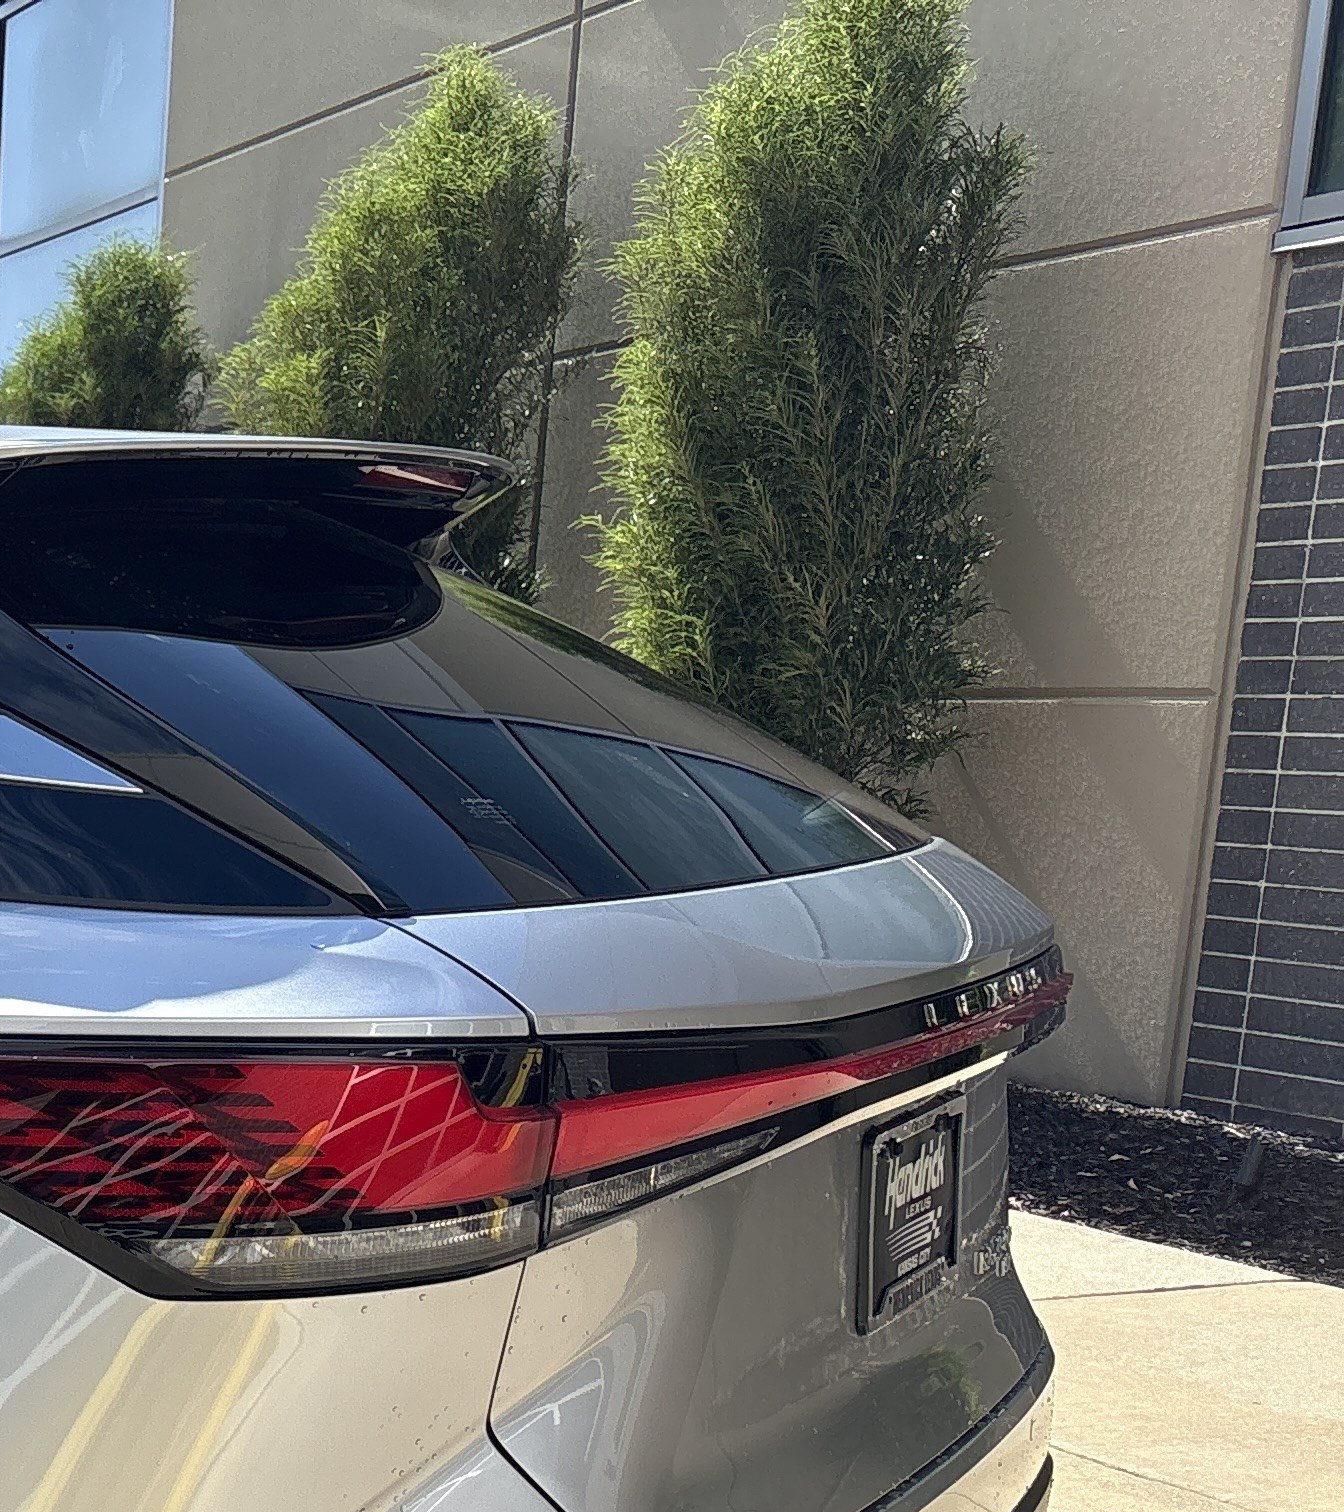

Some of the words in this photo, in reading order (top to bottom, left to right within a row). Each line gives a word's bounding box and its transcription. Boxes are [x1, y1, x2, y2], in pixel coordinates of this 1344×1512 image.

[923, 967, 1042, 1028] LEXUS
[884, 1132, 946, 1230] Hendrick
[905, 1196, 931, 1219] LEXUS
